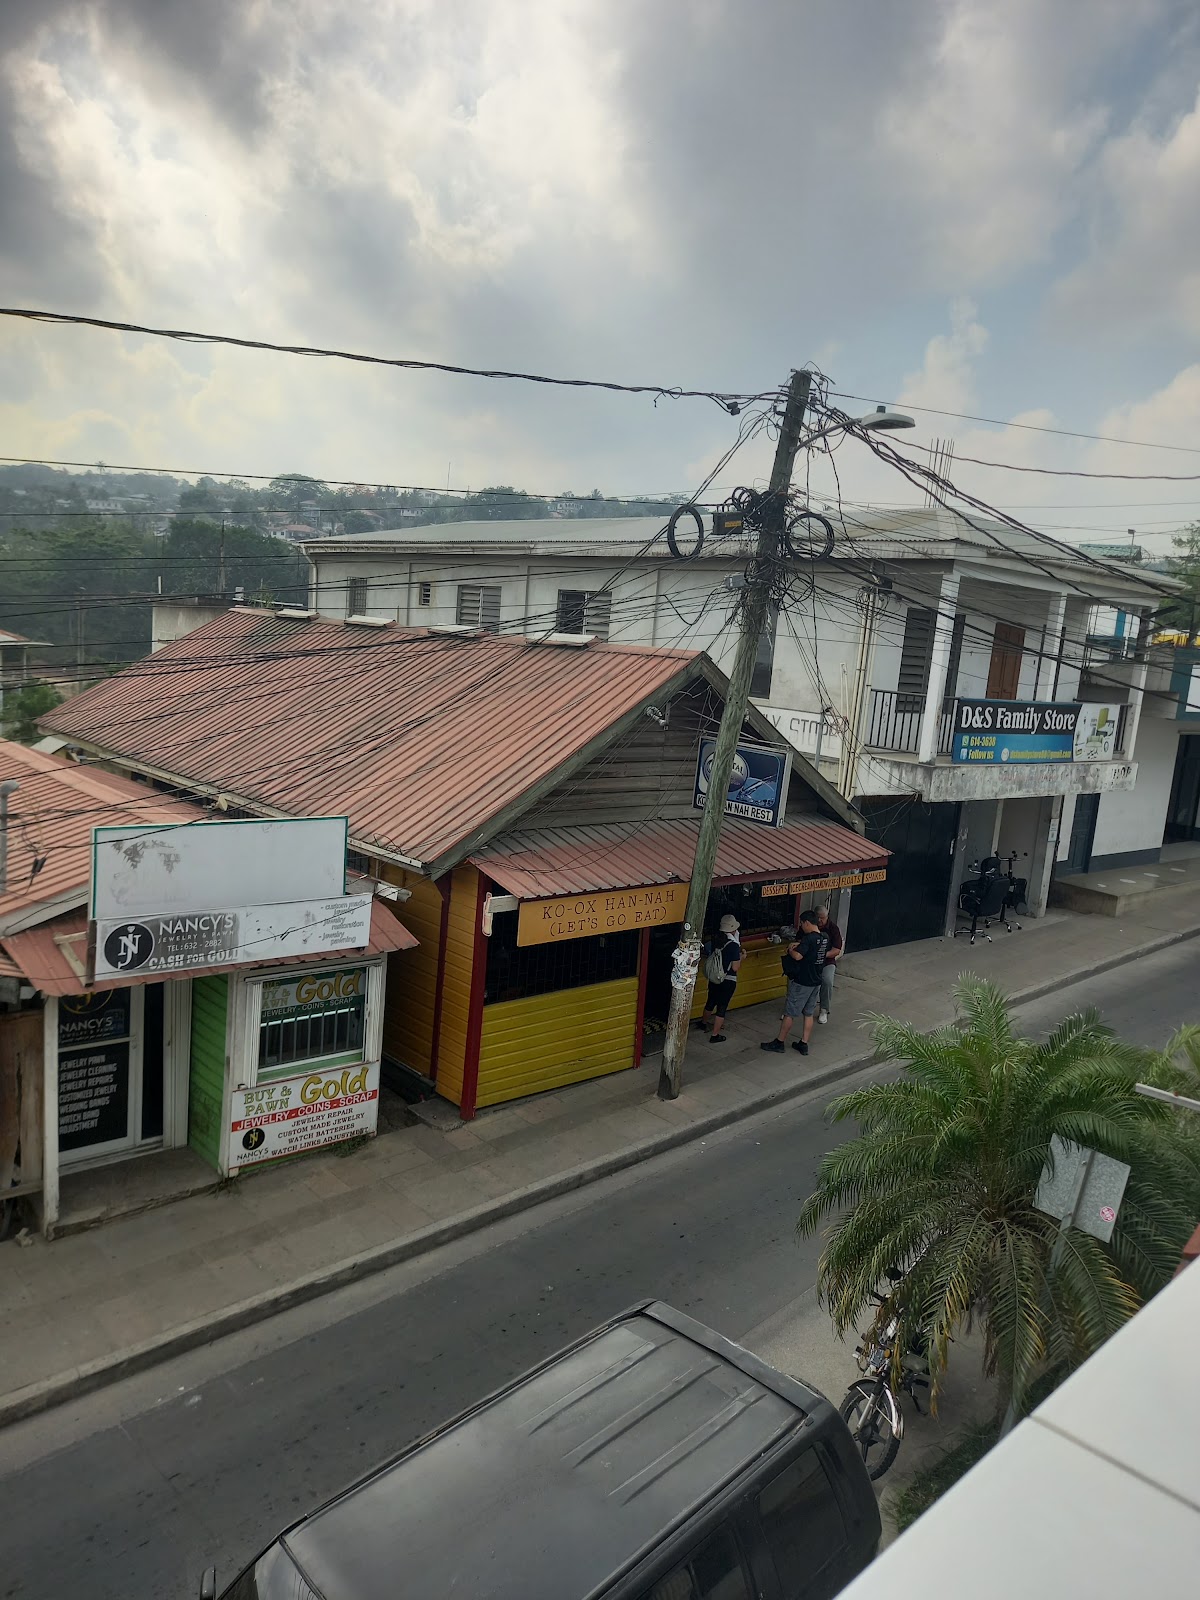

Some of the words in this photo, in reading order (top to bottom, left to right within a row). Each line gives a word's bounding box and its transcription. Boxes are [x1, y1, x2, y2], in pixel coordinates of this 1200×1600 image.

[961, 705, 993, 729] D&S
[996, 707, 1042, 735] Family
[1043, 709, 1075, 730] Store
[968, 749, 986, 760] Follow
[723, 802, 749, 816] AN-NAH
[751, 807, 771, 821] REST.
[841, 875, 861, 886] FLOATS
[542, 900, 597, 920] KO-OX
[605, 890, 675, 911] HAN-NAH
[159, 914, 234, 936] NANCY'S
[550, 917, 598, 937] (LET'S
[606, 913, 626, 927] GO
[634, 906, 667, 923] EAT)
[158, 933, 198, 944] JEWELRY
[211, 930, 234, 938] PAWN
[149, 954, 184, 970] CASH
[187, 953, 205, 964] FOR
[207, 948, 239, 963] GOLD
[262, 990, 278, 1000] UY
[296, 970, 361, 1003] Gold
[262, 997, 288, 1010] AWN
[262, 1006, 296, 1017] JEWELRY
[302, 1001, 324, 1011] COINS
[329, 997, 353, 1006] SCRAP
[60, 1058, 88, 1070] JEWELRY
[60, 1069, 87, 1082] JEWELRY
[300, 1066, 369, 1104] Gold
[60, 1080, 87, 1093] JEWELRY
[244, 1087, 276, 1105] BUY
[281, 1086, 292, 1097] &
[237, 1111, 290, 1130] JEWELRY
[298, 1102, 331, 1116] COINS
[339, 1091, 373, 1107] SCRAP
[245, 1097, 290, 1117] PAWN
[278, 1127, 308, 1139] CUSTOM
[310, 1121, 331, 1131] MADE
[333, 1112, 365, 1126] JEWELRY
[291, 1114, 325, 1128] JEWELRY
[327, 1108, 353, 1119] REPAIR
[271, 1145, 298, 1156] WATCH
[300, 1139, 321, 1150] LINKS
[323, 1127, 369, 1143] ADJUSTMENT
[288, 1131, 314, 1144] WATCH
[316, 1123, 355, 1136] BATTERIES
